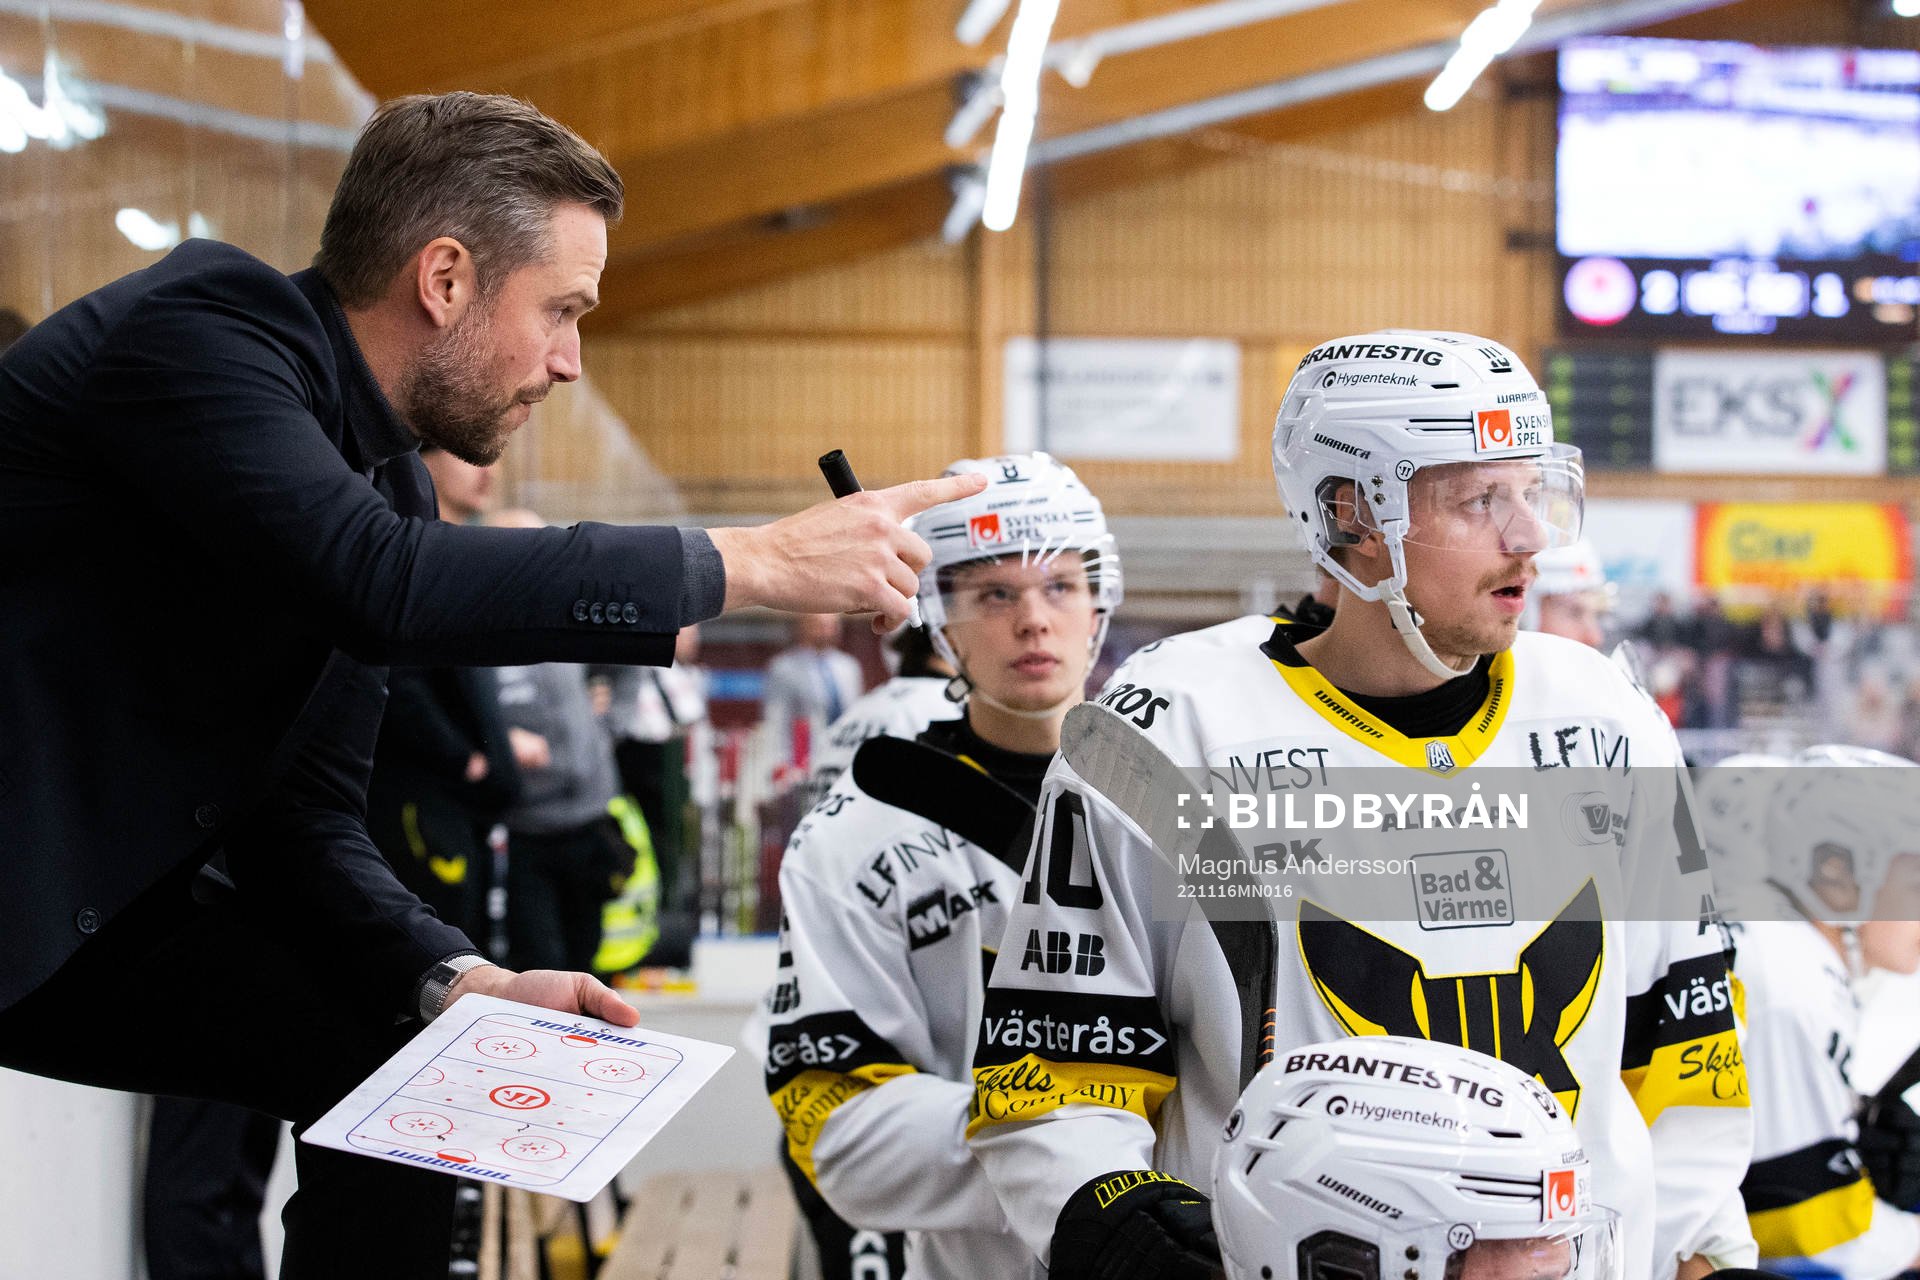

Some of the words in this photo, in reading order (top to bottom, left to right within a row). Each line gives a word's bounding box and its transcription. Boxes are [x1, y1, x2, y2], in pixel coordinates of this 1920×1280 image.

[1297, 343, 1444, 371] BRANTESTIG
[1337, 371, 1419, 388] Hygienteknik
[1517, 432, 1542, 446] SPEL
[1099, 683, 1170, 730] ROS
[1313, 689, 1385, 740] WARRIOR
[1477, 677, 1505, 735] WARRIOR
[1528, 725, 1582, 772] LF
[1022, 789, 1104, 911] 10
[1420, 869, 1471, 896] Bad
[1474, 855, 1505, 891] &
[1424, 898, 1507, 922] Värme
[1021, 928, 1106, 976] ABB
[976, 1061, 1055, 1096] Skills
[1284, 1053, 1504, 1108] BRANTESTIG
